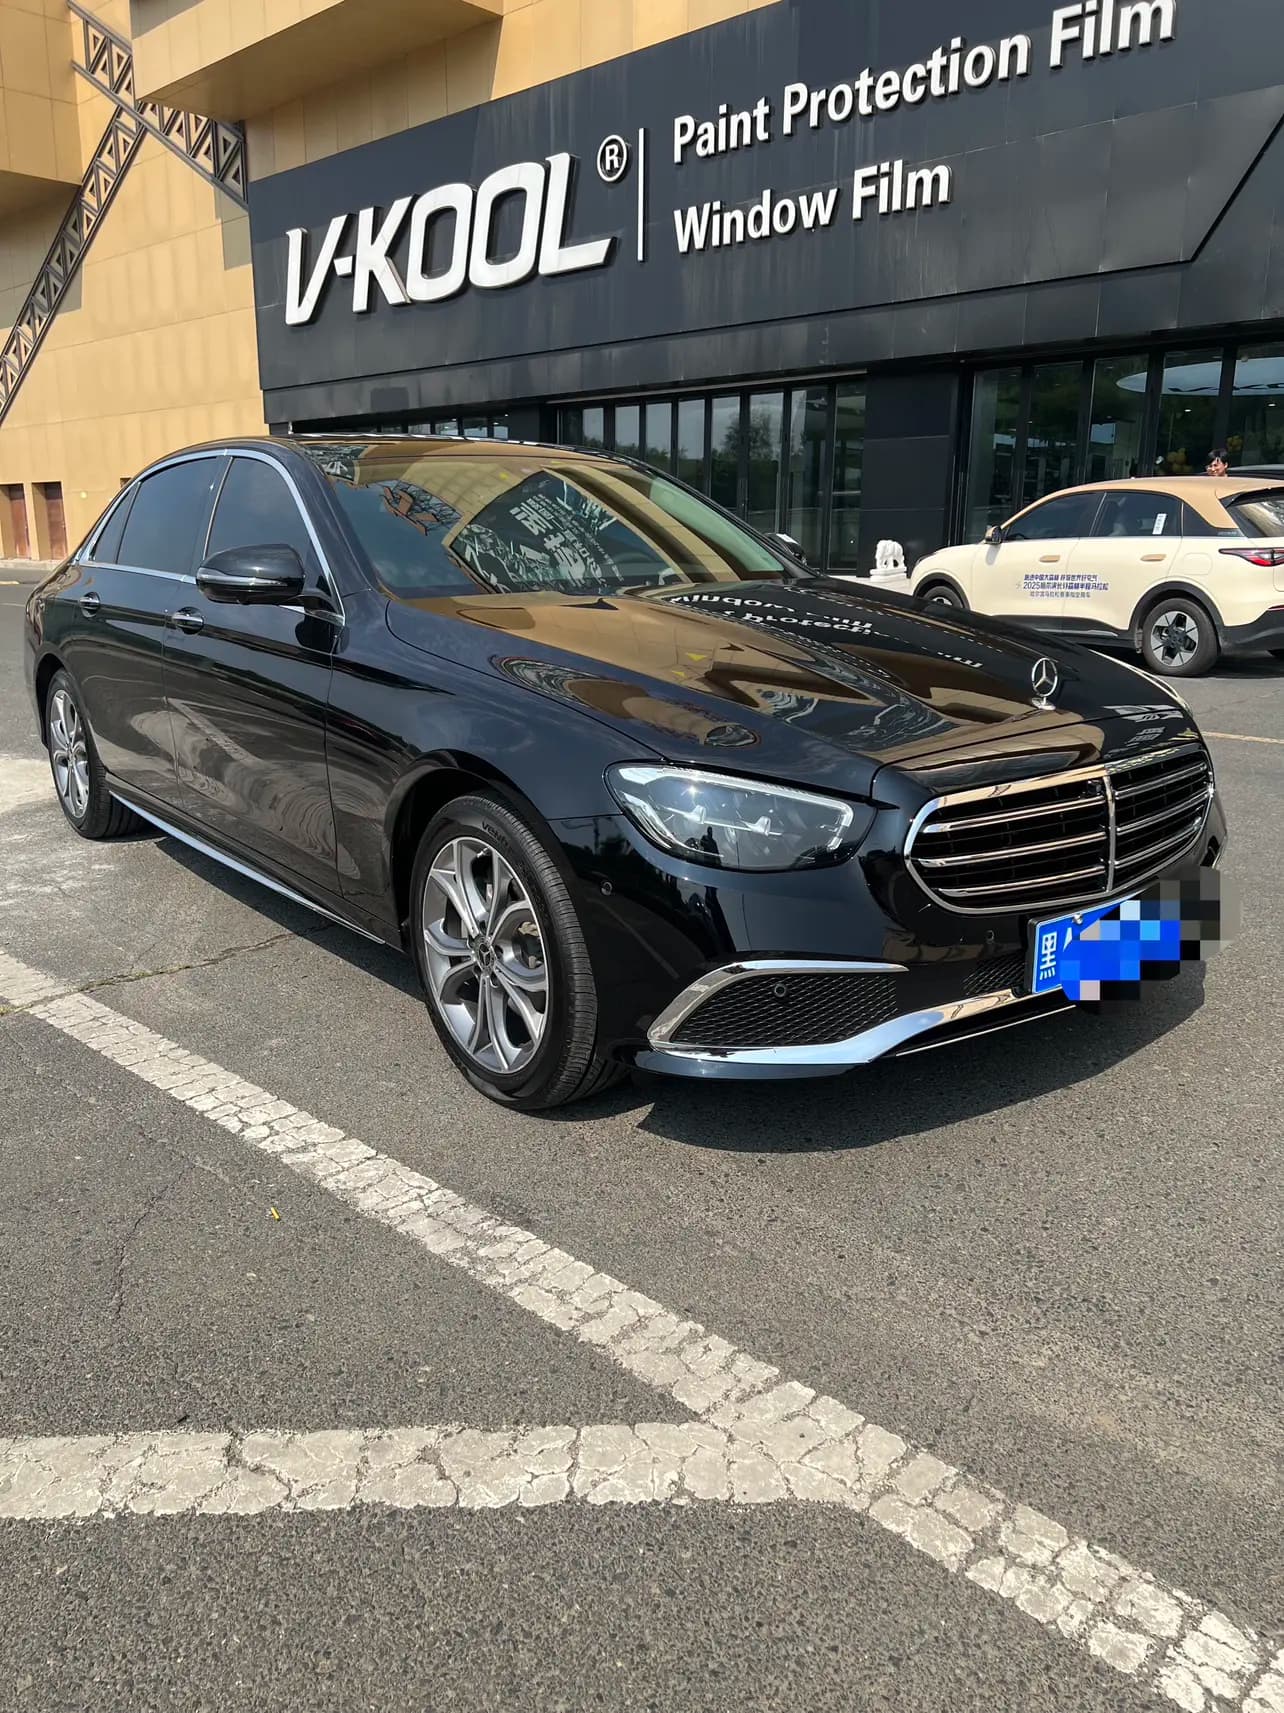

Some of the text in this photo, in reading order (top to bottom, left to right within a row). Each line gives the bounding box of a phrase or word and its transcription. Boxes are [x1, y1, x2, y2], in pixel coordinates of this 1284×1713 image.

[672, 0, 1176, 164] Paint Protection Film
[284, 152, 617, 326] V-KOOL
[673, 158, 951, 254] Window Film
[1039, 931, 1058, 980] 黑
